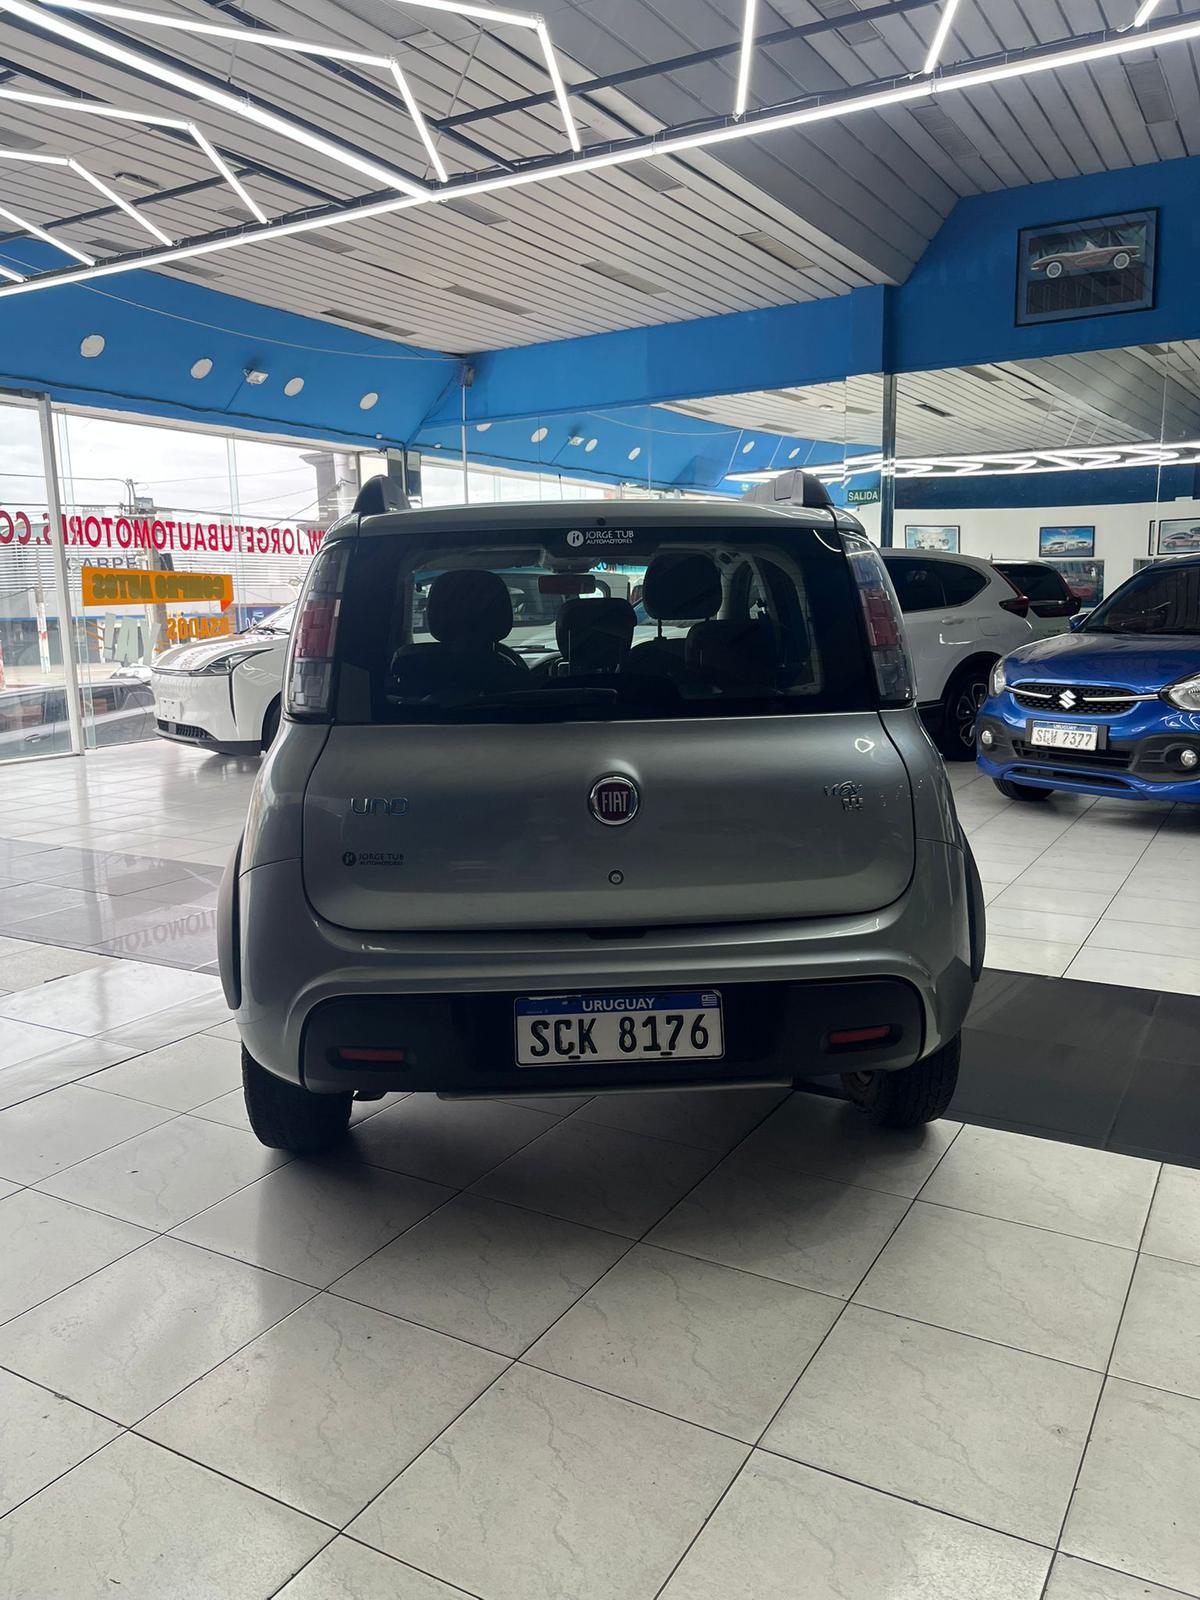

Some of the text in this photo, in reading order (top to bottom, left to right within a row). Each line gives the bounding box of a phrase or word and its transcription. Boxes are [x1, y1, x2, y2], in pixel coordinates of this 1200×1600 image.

[848, 491, 878, 501] SALIDA
[585, 530, 634, 539] JORGE TUB
[601, 791, 629, 812] FIAT
[582, 997, 656, 1012] URUGUAY
[530, 1014, 709, 1057] SCK 8176
